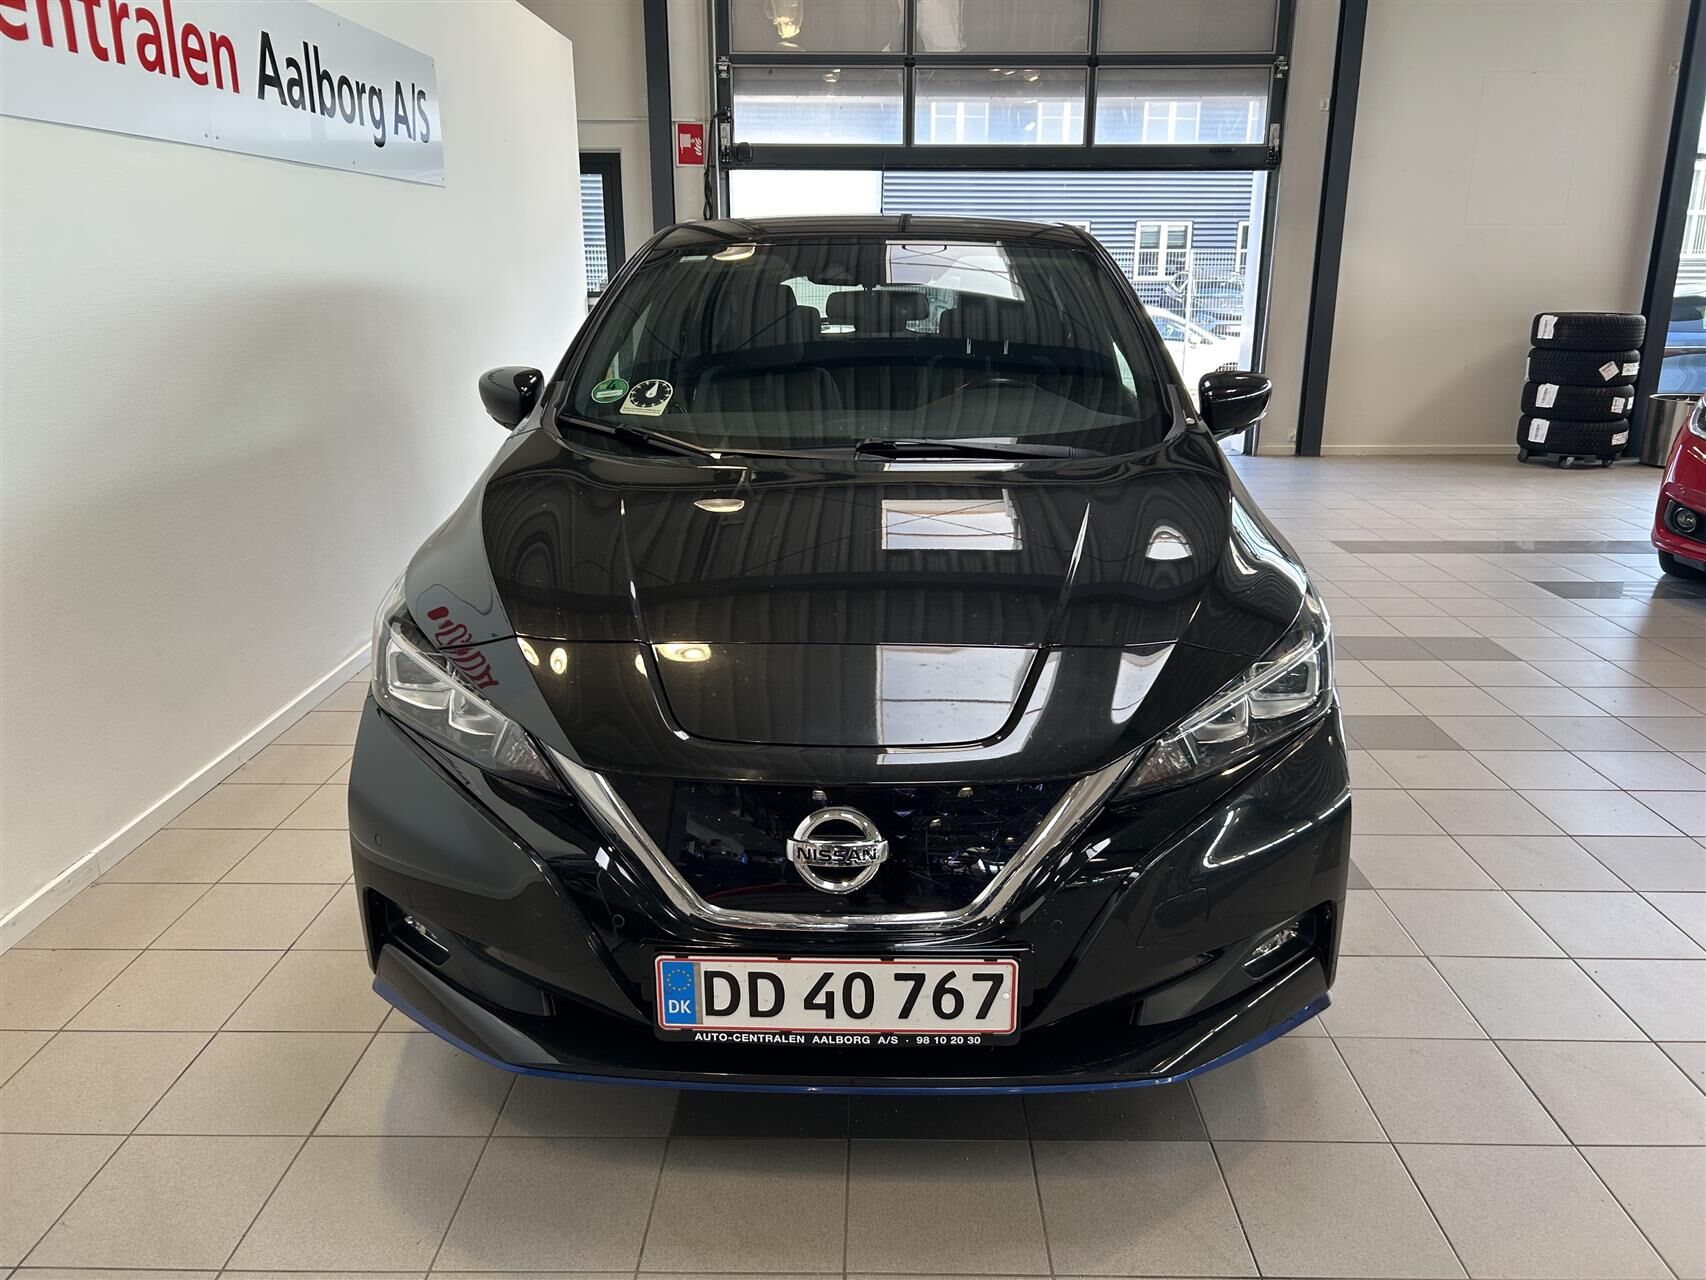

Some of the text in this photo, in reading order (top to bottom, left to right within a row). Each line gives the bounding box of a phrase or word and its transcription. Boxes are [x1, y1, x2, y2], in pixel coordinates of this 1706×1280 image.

[258, 30, 386, 148] Aalborg
[393, 80, 431, 144] A/S
[606, 380, 617, 390] 4
[797, 847, 877, 861] NISSAN
[703, 970, 1005, 1021] DD 40 767
[668, 999, 692, 1015] DK
[694, 1032, 982, 1045] AUTO-CENTRALEN AALBORG A/S 98 10 20 30
